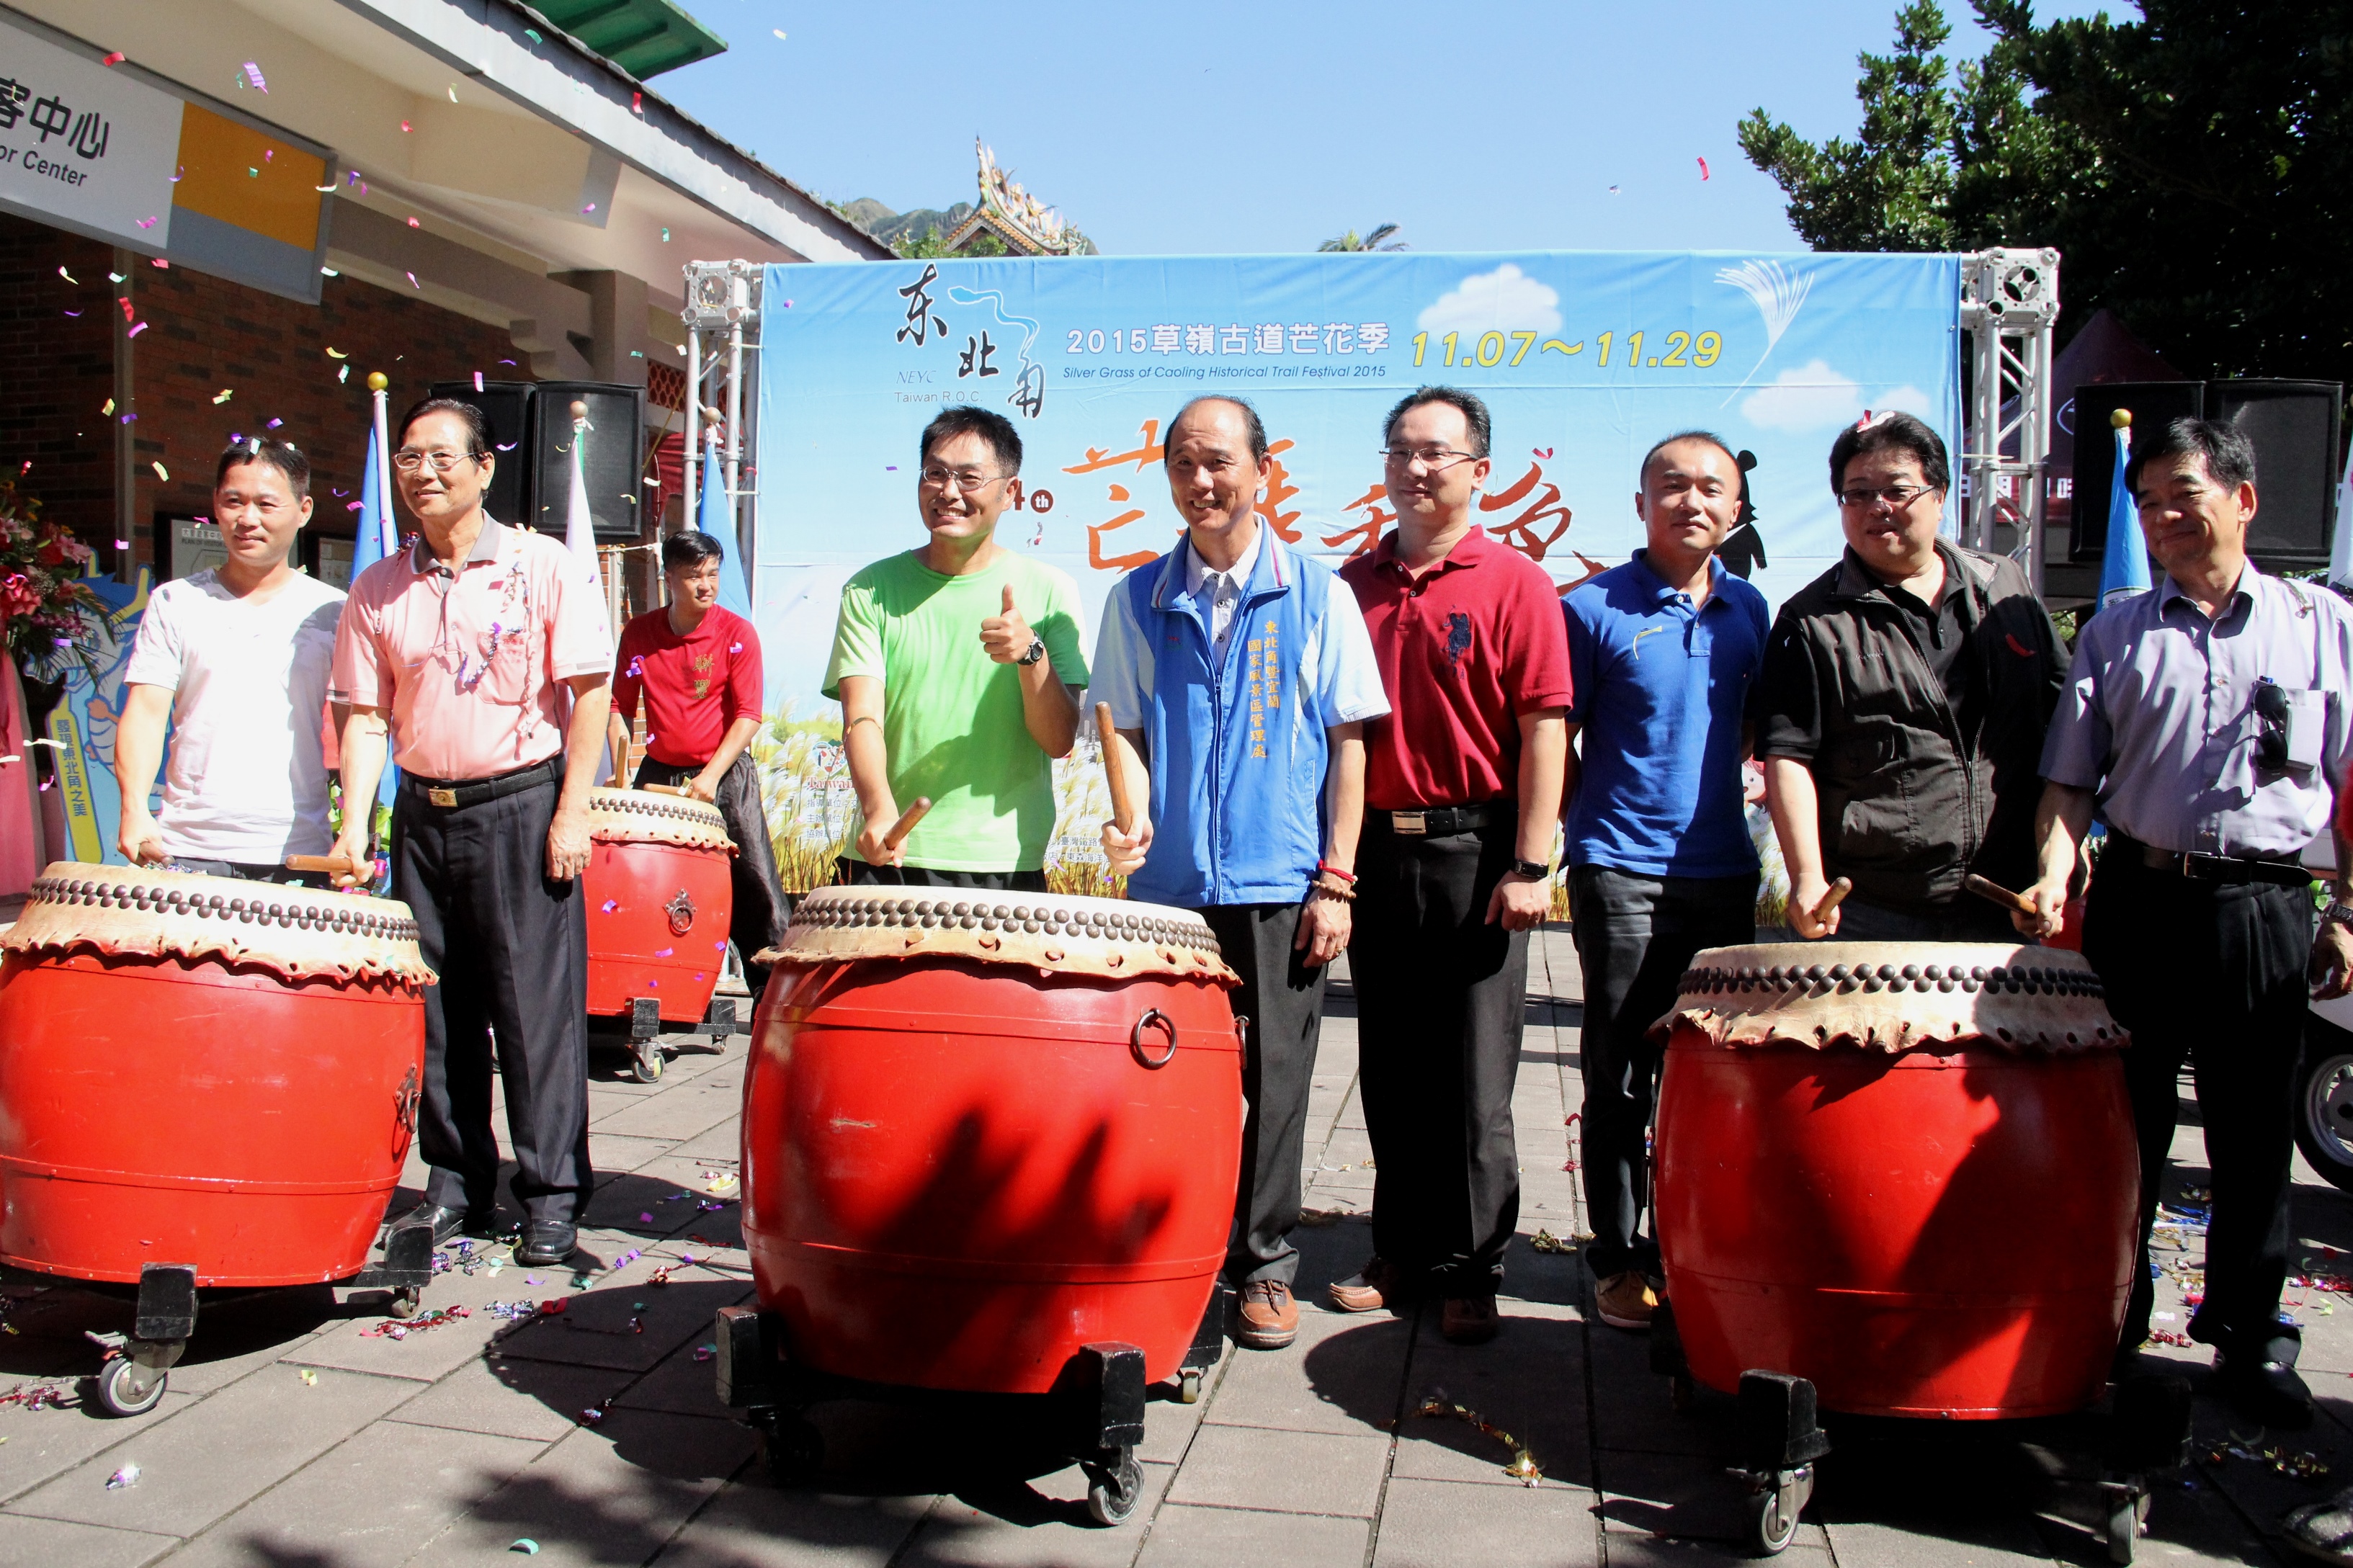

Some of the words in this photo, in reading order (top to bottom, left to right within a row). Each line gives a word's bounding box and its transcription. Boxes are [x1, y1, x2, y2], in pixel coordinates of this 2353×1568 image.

[23, 151, 87, 187] Center
[1066, 323, 1390, 357] 2015草嶺古道芒花季
[896, 370, 937, 384] NEYC
[1063, 367, 1096, 378] Silver
[1099, 367, 1135, 378] Grass
[1138, 367, 1152, 378] of
[1154, 367, 1205, 380] Caoling
[1209, 366, 1268, 378] Historical
[1272, 366, 1299, 377] Trail
[1302, 365, 1350, 378] Festival
[1353, 365, 1386, 377] 2015
[895, 391, 938, 403] Taiwan
[942, 390, 983, 403] R.O.C.
[1264, 620, 1282, 709] 東北角暨宜蘭
[1247, 639, 1268, 758] 國家風景區管理處
